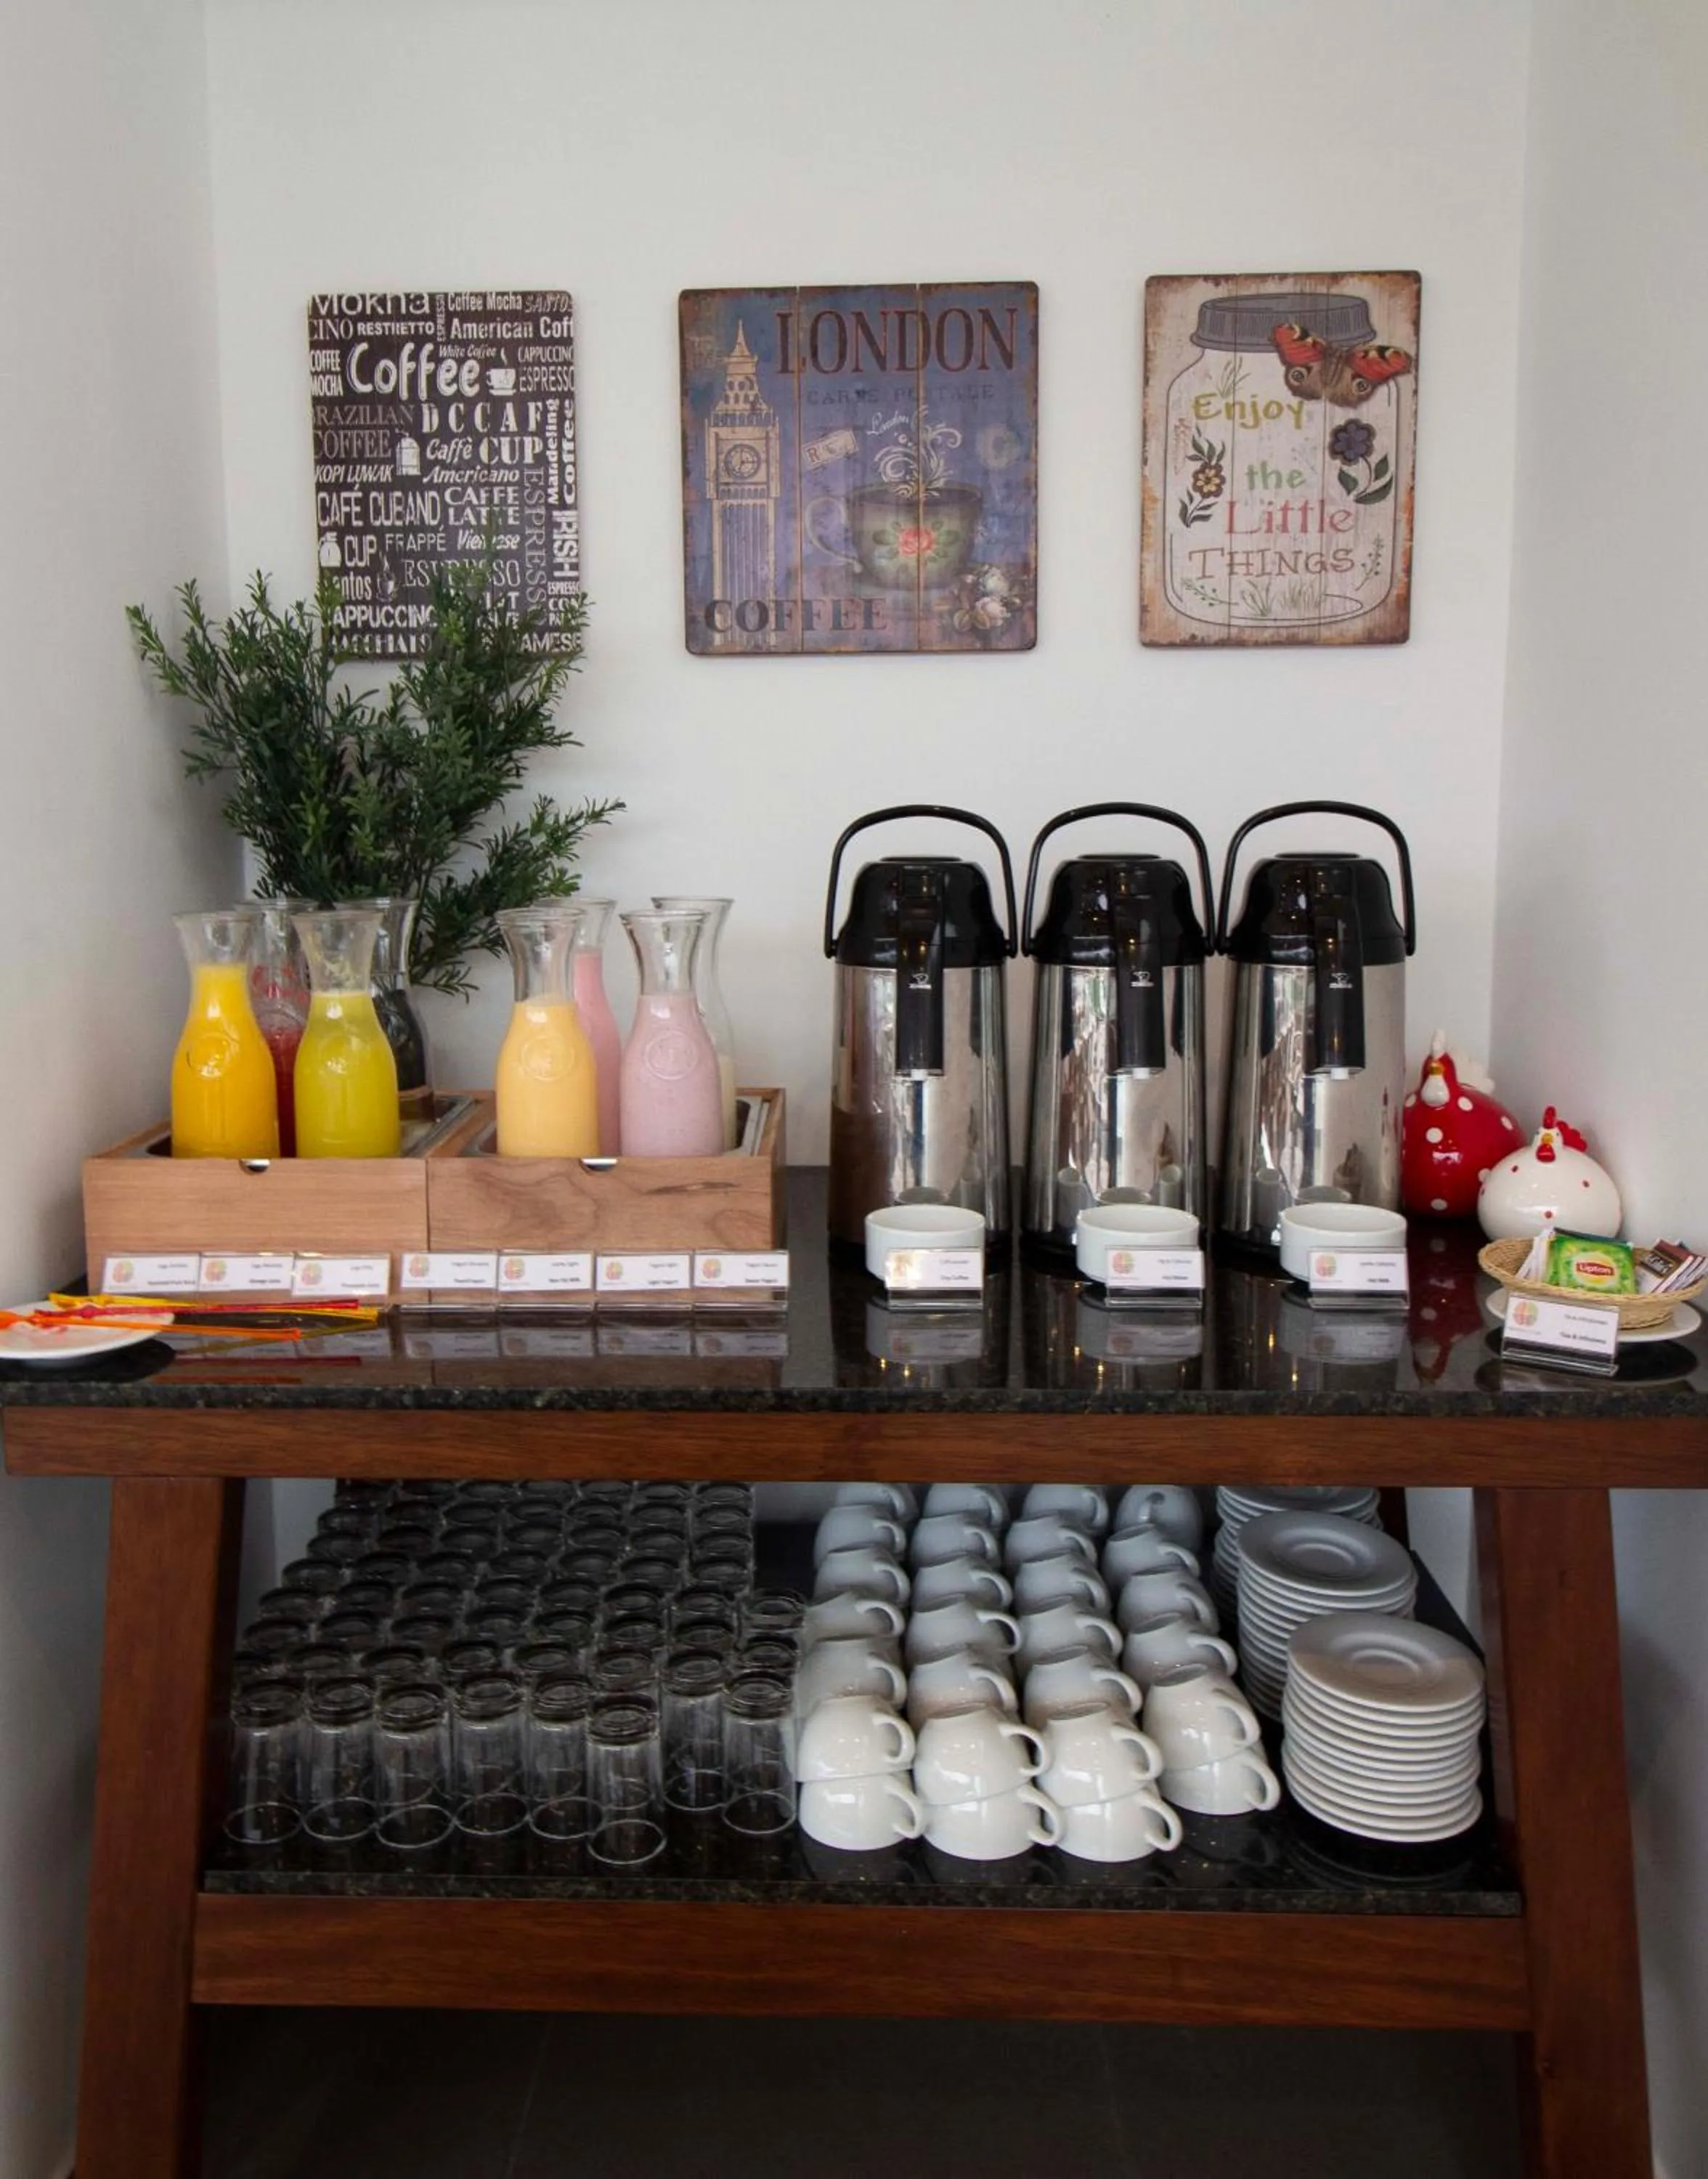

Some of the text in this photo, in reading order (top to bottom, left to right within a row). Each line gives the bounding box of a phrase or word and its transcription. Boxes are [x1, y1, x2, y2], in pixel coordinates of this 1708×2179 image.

[448, 291, 522, 312] Coffee Mocha
[450, 317, 534, 339] American
[776, 307, 1018, 375] LONDON
[311, 349, 341, 372] COFFEE
[346, 341, 480, 400] Coffee
[311, 374, 343, 397] MOCHA
[314, 404, 415, 426] RAZILIAN
[1192, 393, 1305, 429] Enjoy
[479, 437, 543, 464] CUP
[315, 465, 346, 483] KOPI
[423, 465, 520, 484] Americano
[1245, 460, 1306, 490] the
[1224, 499, 1354, 534] Little
[344, 534, 377, 567] CUP
[552, 510, 580, 577] IRISH
[1189, 548, 1355, 580] THINGS
[328, 604, 439, 628] APPUCCINO
[704, 598, 887, 633] COFFEE
[1579, 1263, 1611, 1275] Lipton
